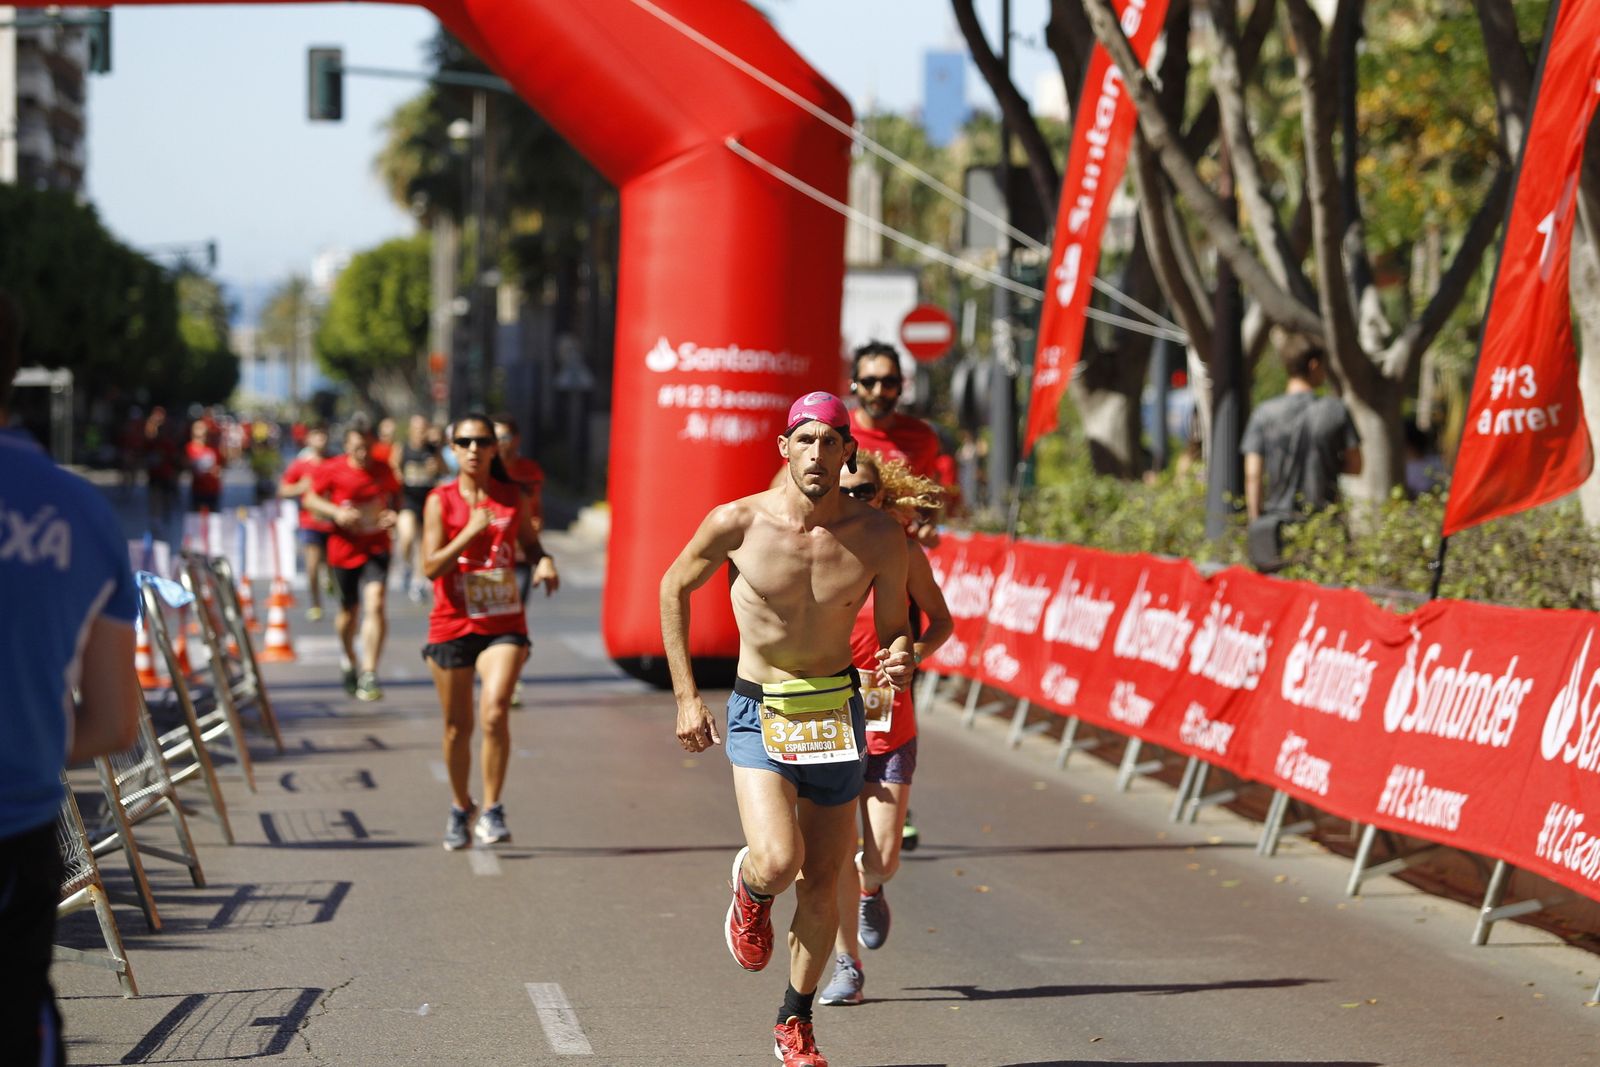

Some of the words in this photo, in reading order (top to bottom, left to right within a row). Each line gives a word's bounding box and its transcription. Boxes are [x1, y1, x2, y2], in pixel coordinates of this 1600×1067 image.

[677, 341, 812, 376] Santander
[1401, 642, 1534, 748] Santander
[770, 719, 838, 743] 3215
